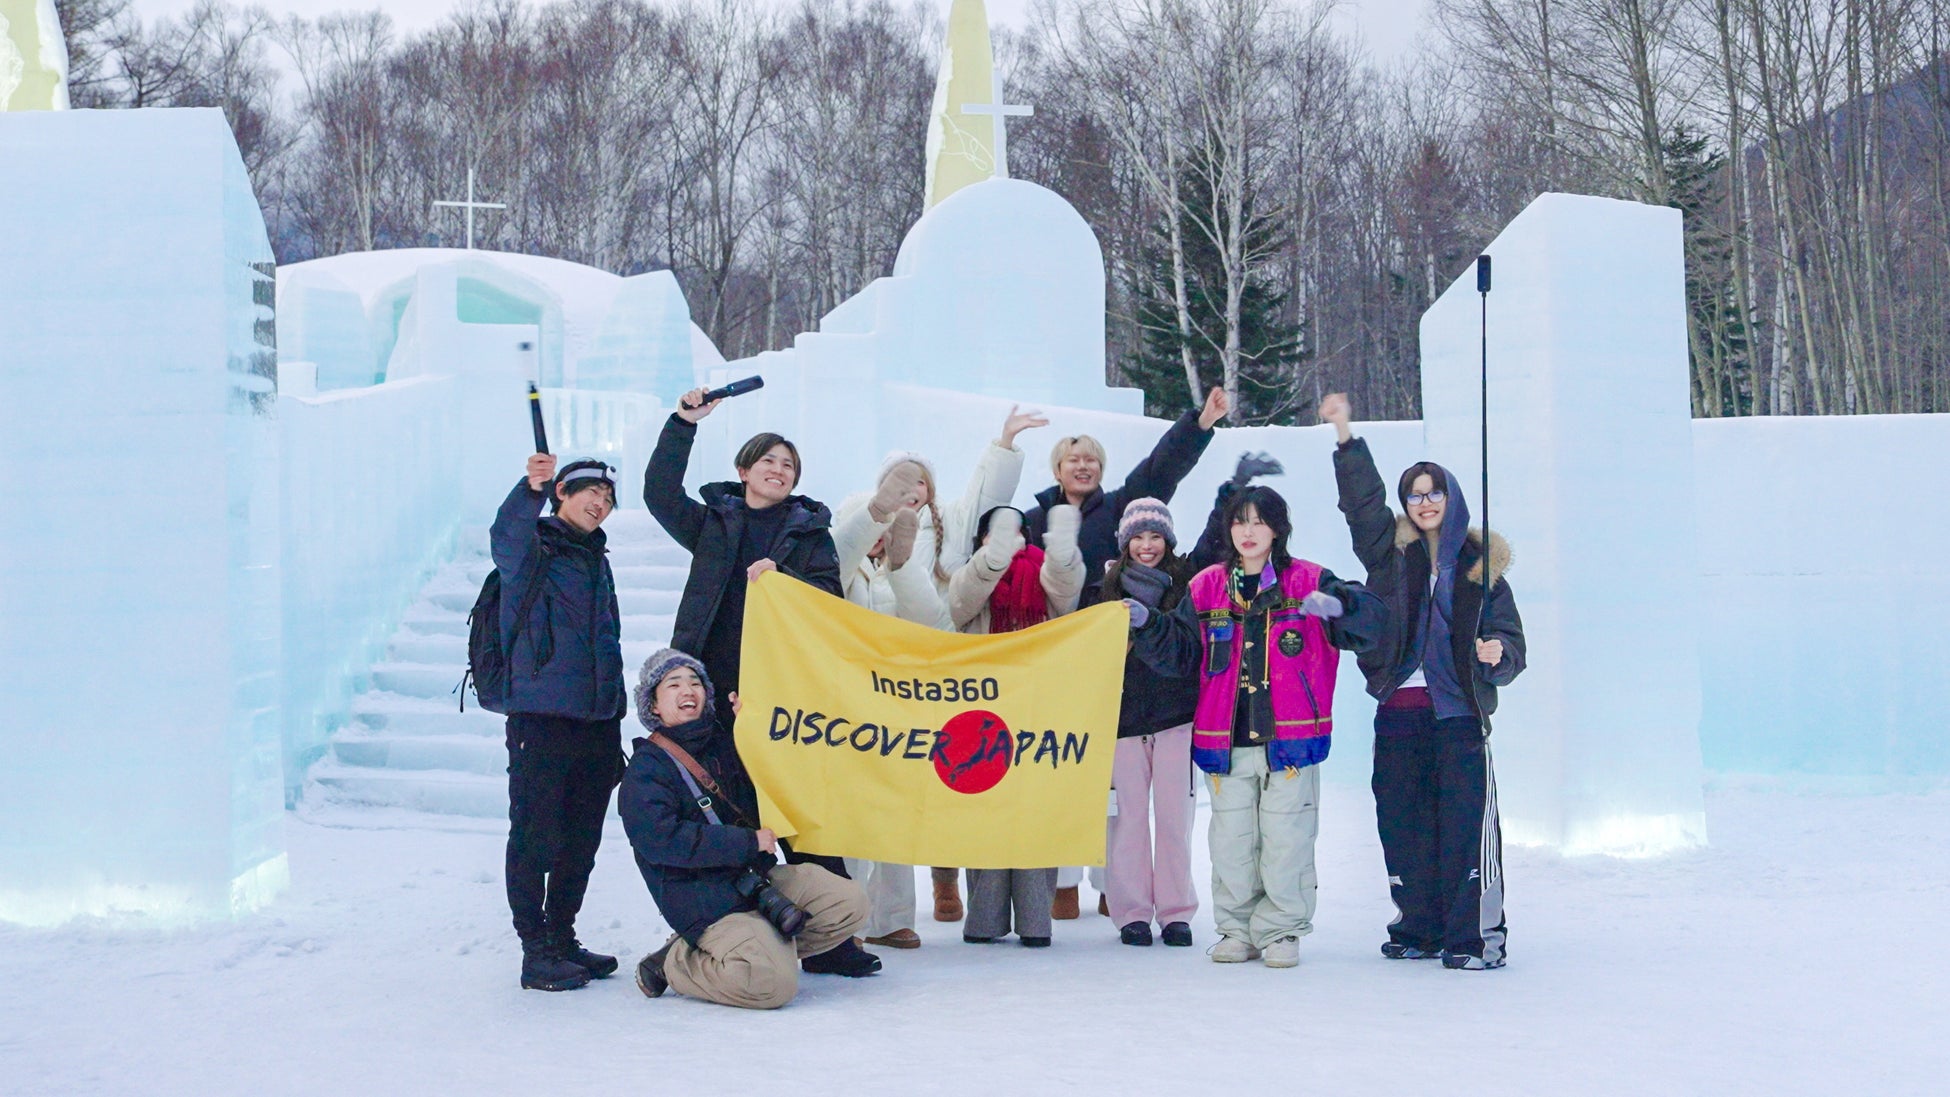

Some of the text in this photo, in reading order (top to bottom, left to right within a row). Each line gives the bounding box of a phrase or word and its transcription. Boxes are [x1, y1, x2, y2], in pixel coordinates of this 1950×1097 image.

[871, 670, 999, 703] Insta360
[768, 706, 1089, 781] DISCOVER JAPAN
